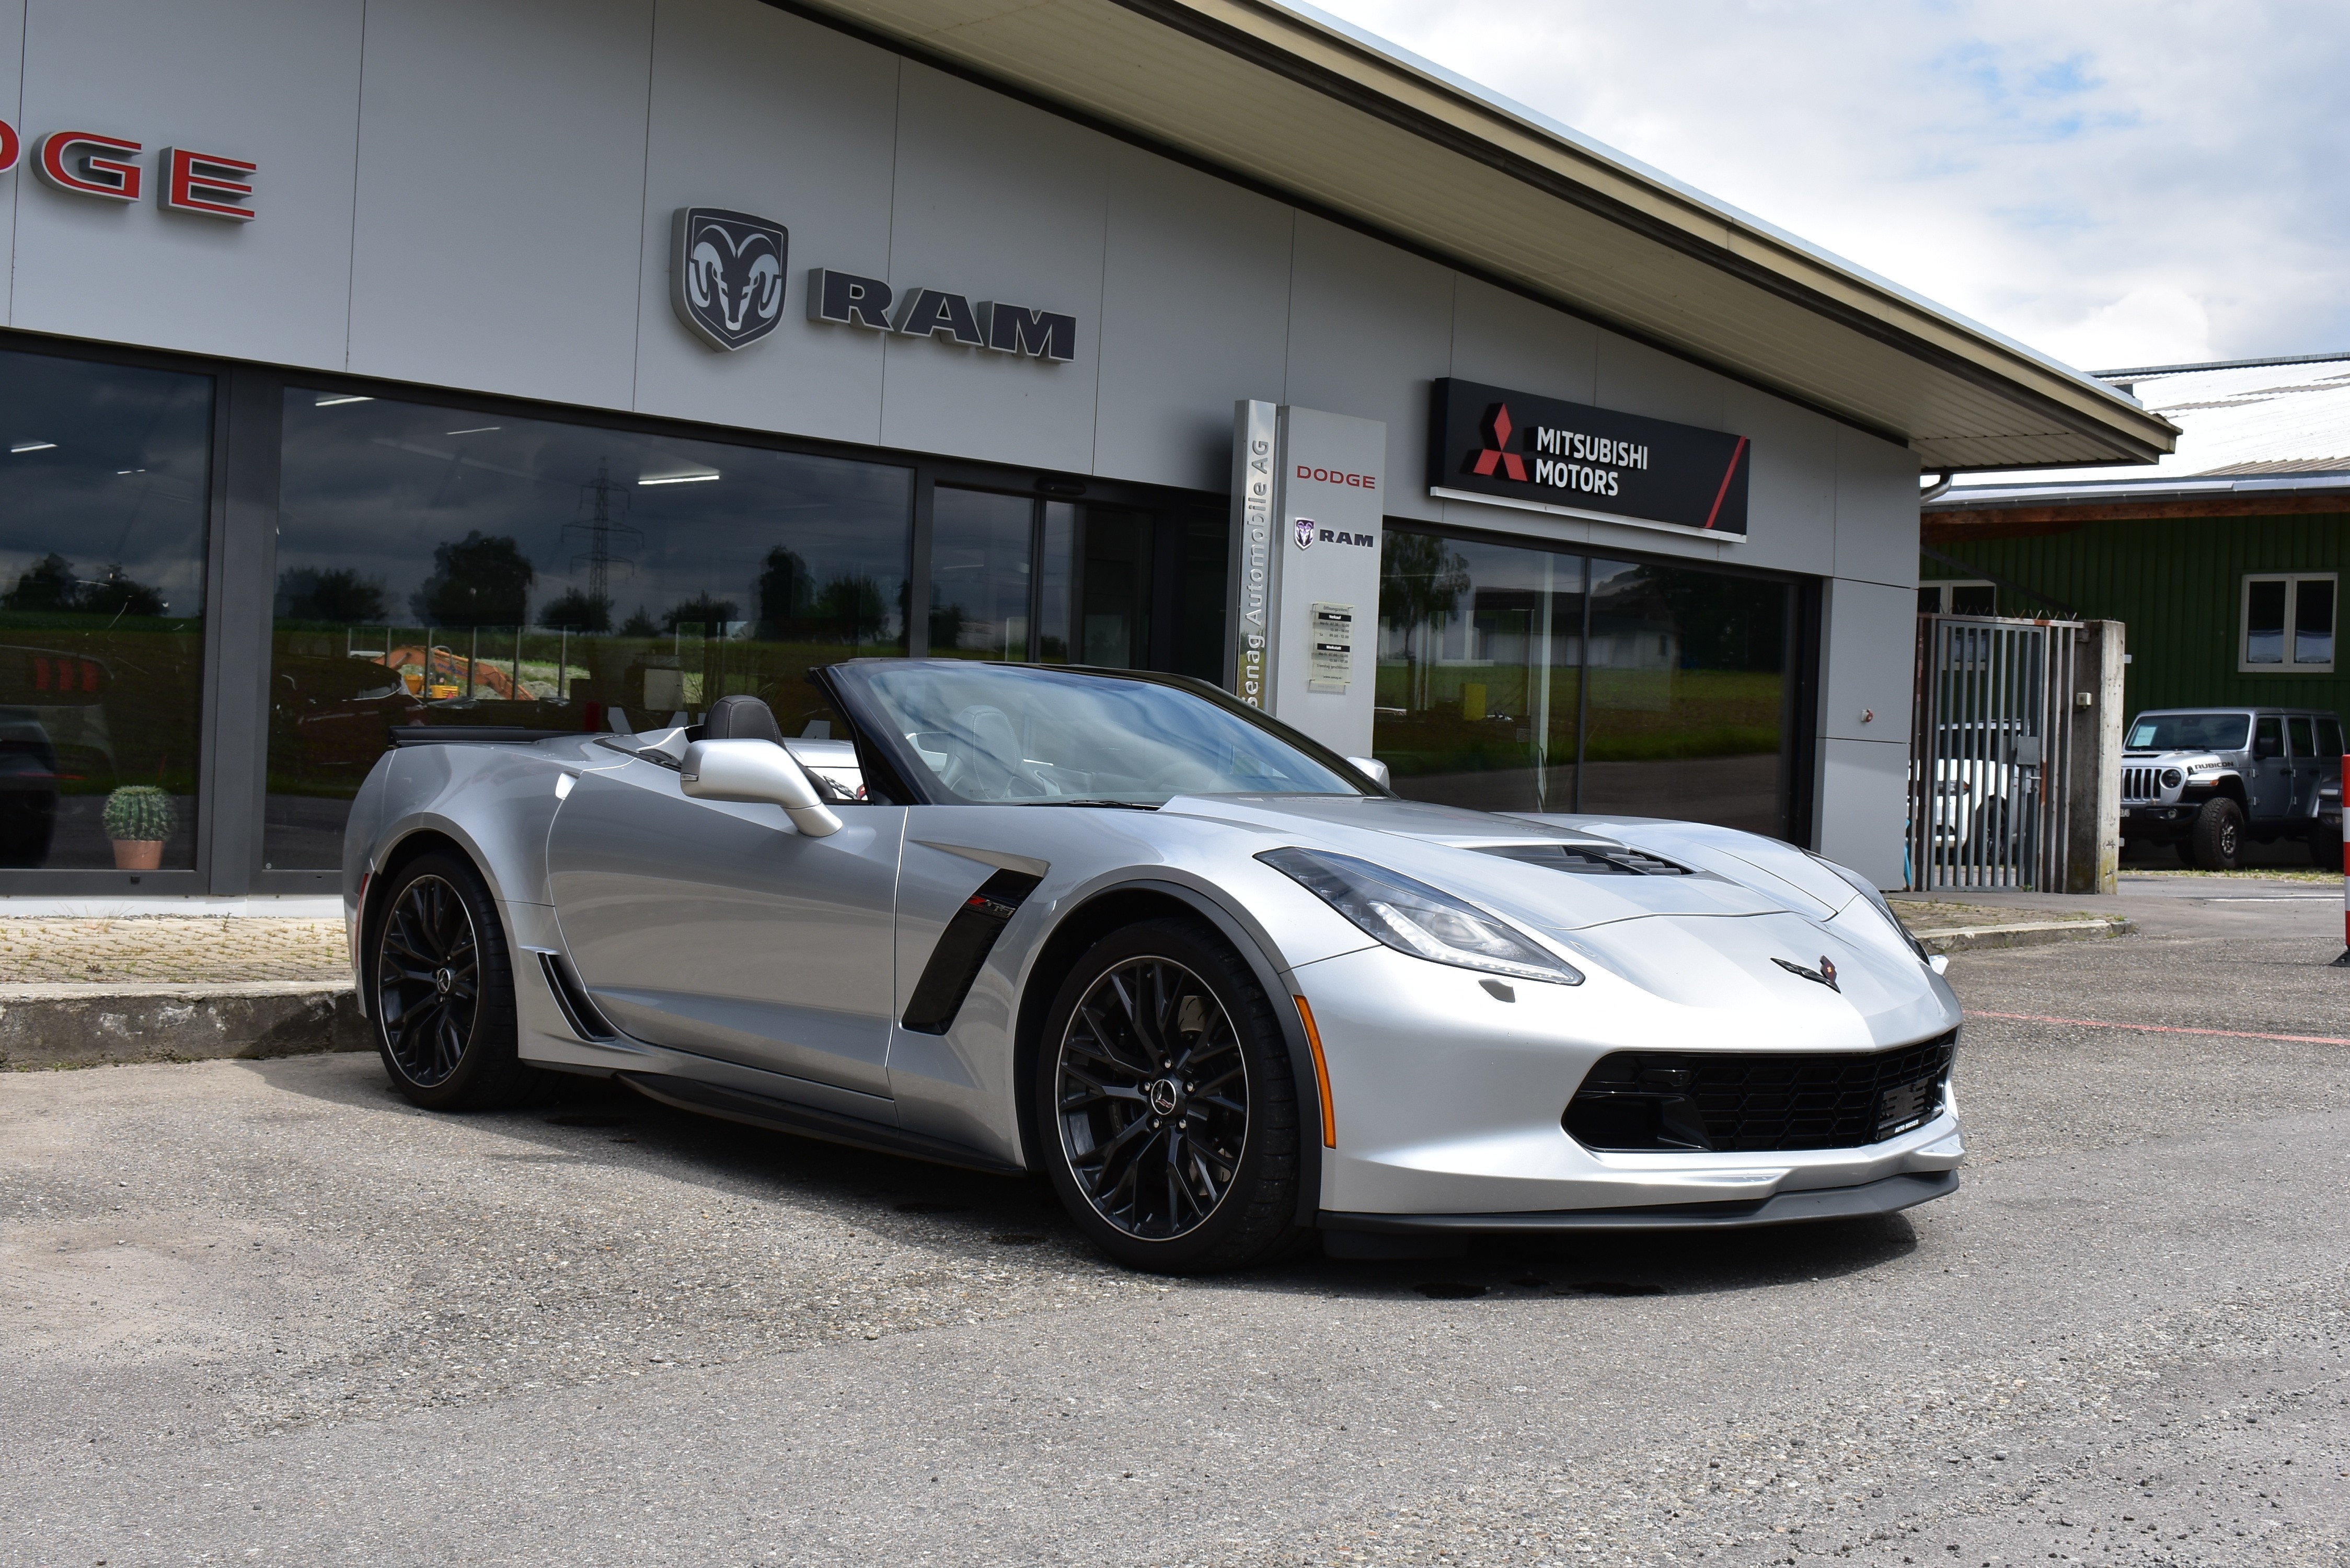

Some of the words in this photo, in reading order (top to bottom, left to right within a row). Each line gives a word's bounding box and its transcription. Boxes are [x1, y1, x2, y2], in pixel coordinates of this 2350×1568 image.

[0, 119, 256, 223] GE
[807, 268, 1077, 364] RAM
[1251, 440, 1269, 475] AG
[1537, 426, 1648, 470] MITSUBISHI
[1297, 465, 1376, 489] DODGE
[1535, 458, 1619, 496] MOTORS
[1245, 482, 1268, 626] Automobile
[1319, 529, 1374, 548] RAM
[1894, 1124, 1905, 1133] AUTO
